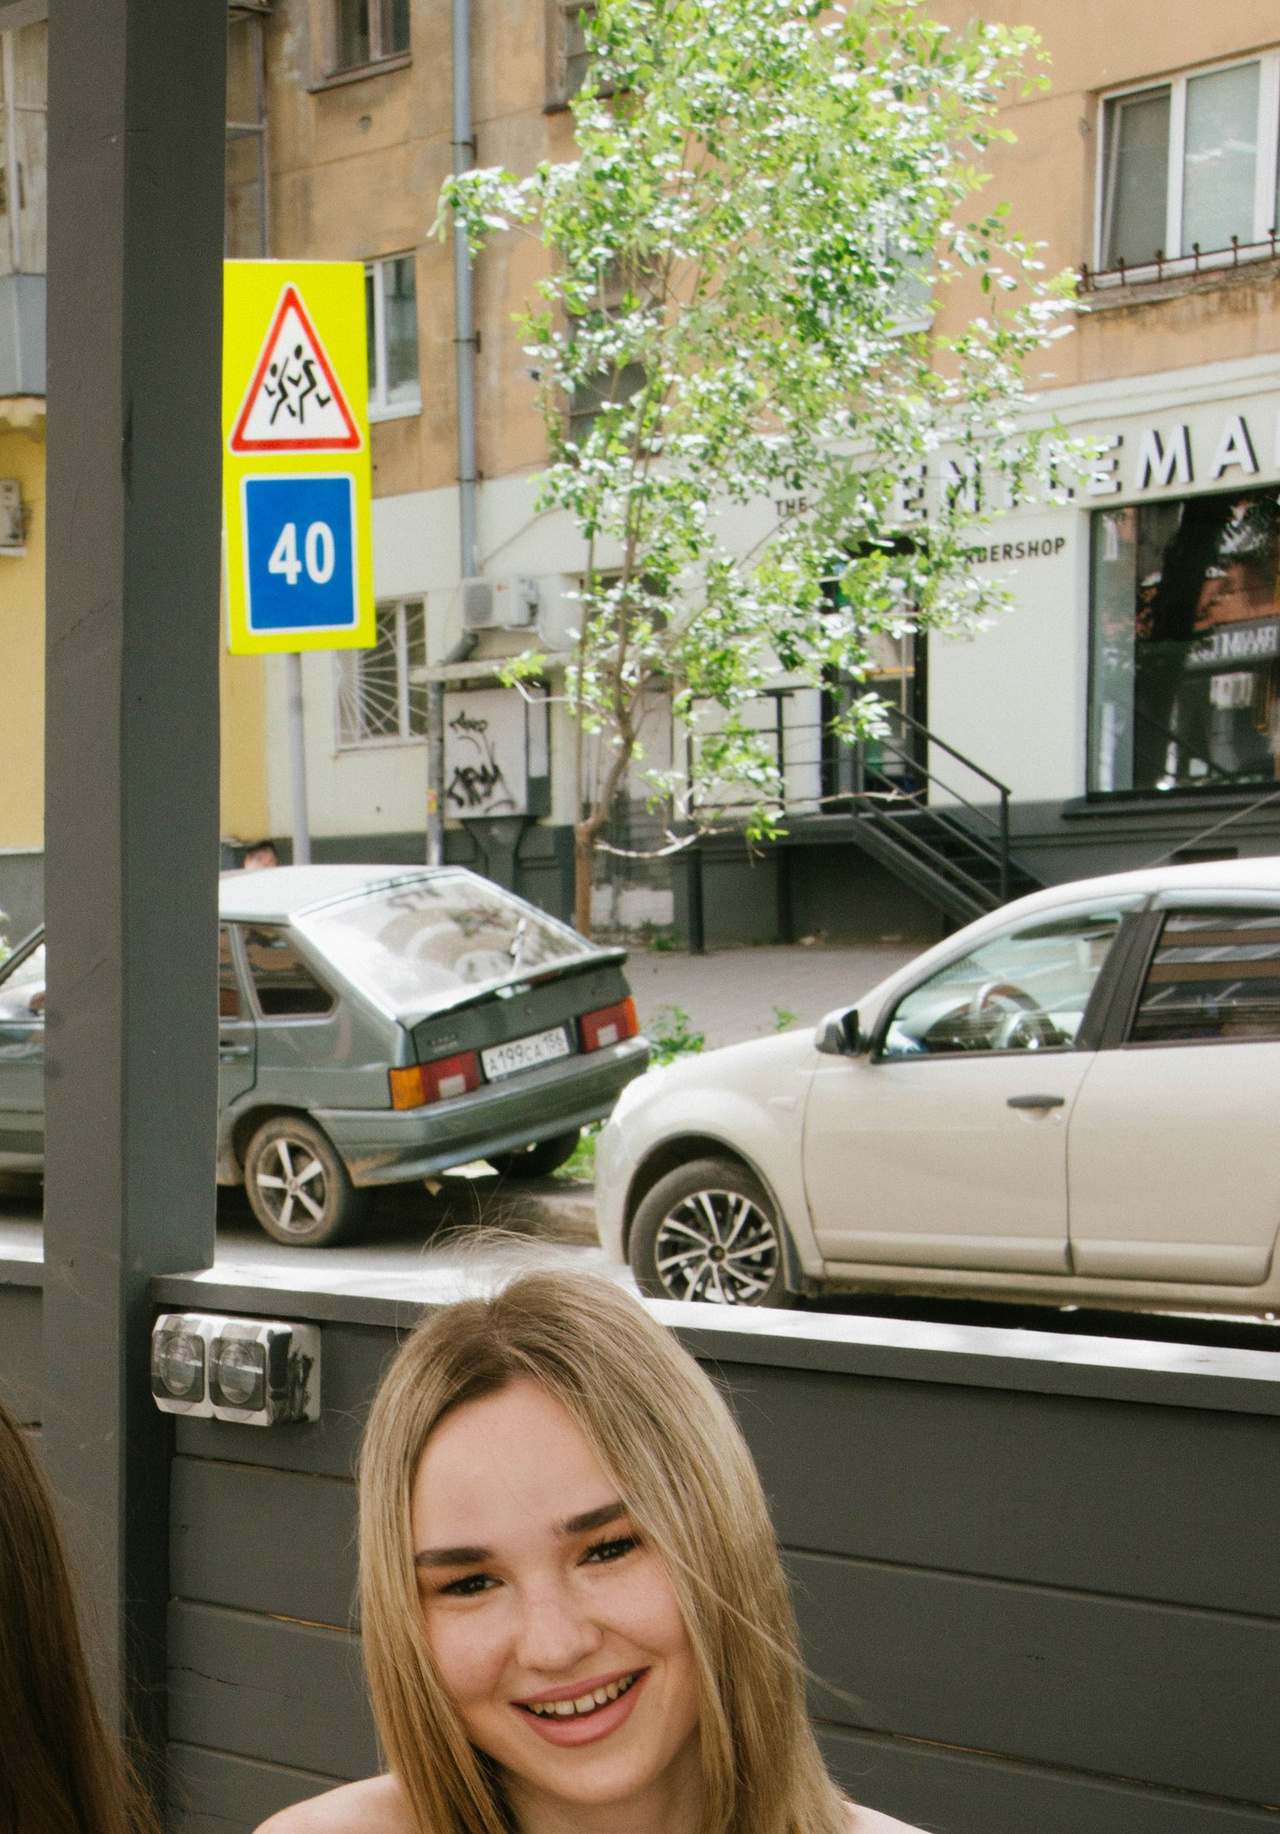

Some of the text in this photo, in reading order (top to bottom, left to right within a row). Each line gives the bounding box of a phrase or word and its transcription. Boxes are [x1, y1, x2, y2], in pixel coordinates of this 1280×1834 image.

[774, 411, 1280, 521] THE ENTLEMA
[268, 521, 335, 585] 40
